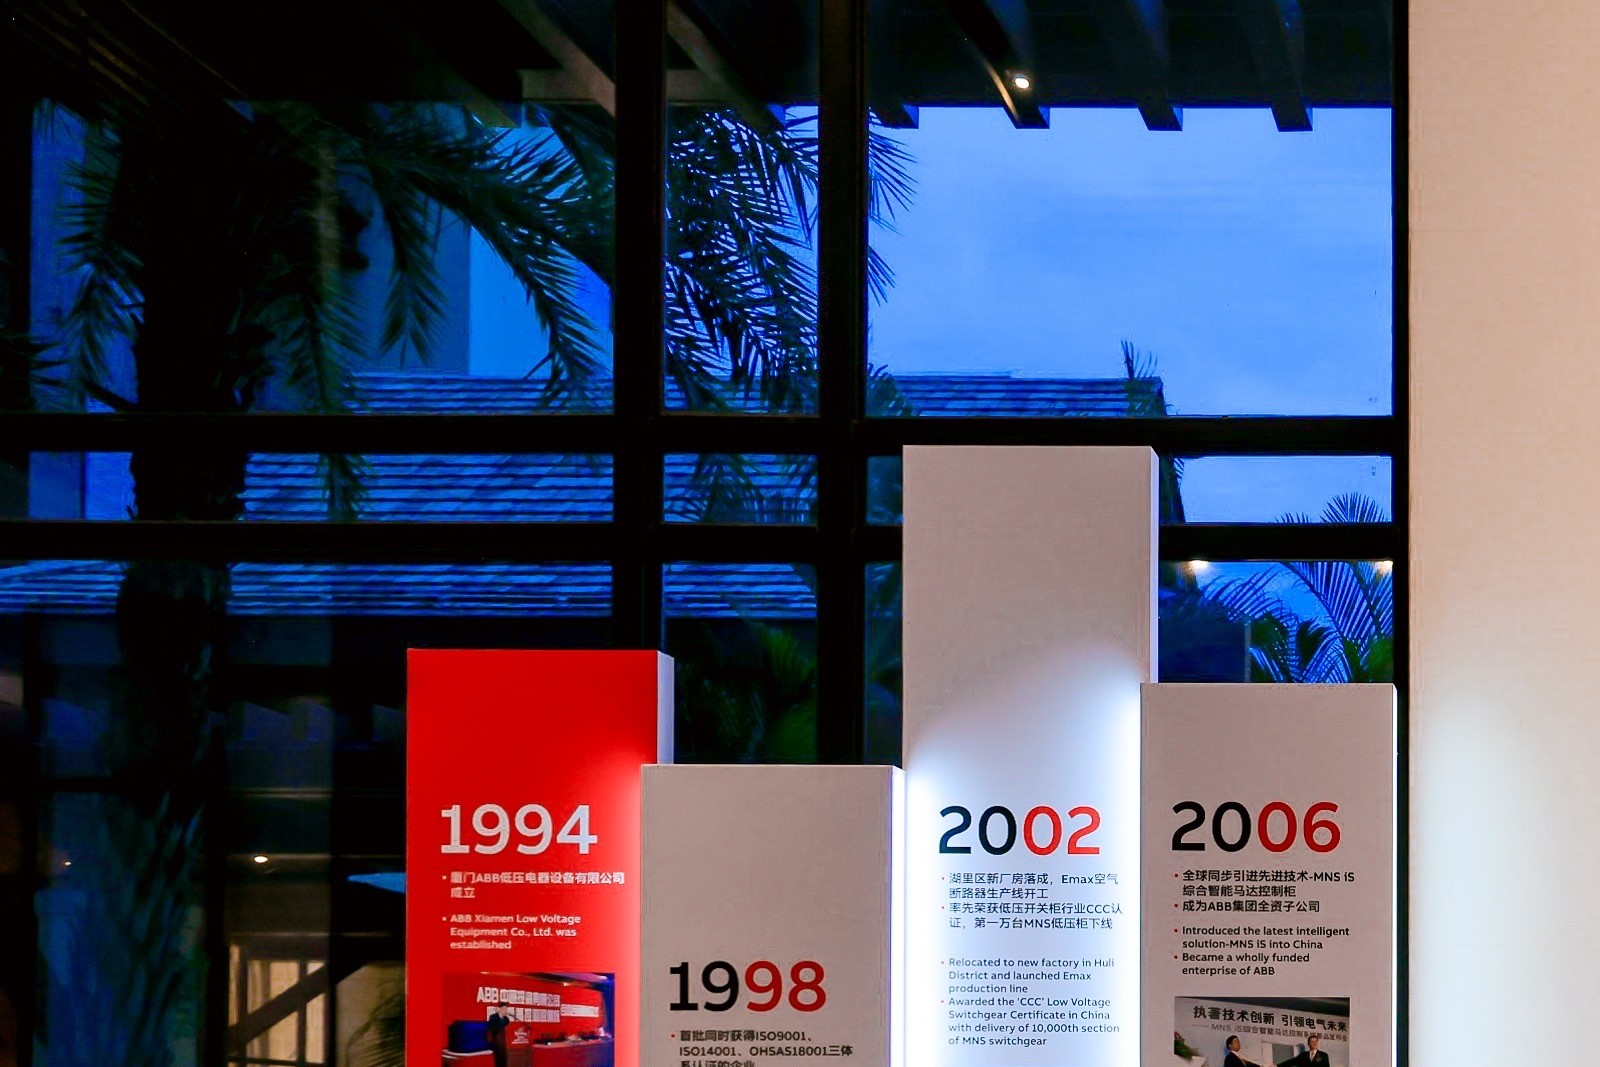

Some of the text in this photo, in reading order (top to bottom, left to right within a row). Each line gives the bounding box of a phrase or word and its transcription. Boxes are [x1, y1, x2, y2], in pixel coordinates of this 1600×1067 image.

[441, 804, 597, 855] 1994
[939, 806, 1100, 855] 2002
[1171, 801, 1341, 852] 2006
[1344, 872, 1354, 882] iS
[1183, 926, 1349, 938] Introduced the latest intelligent
[1183, 939, 1323, 949] solution-MNS iS into China
[950, 958, 1000, 966] Relocated
[1042, 958, 1079, 969] factory
[1183, 953, 1223, 961] Became
[1236, 953, 1269, 964] wholly
[1272, 953, 1309, 962] funded
[1014, 971, 1059, 980] launched
[1182, 966, 1275, 976] enterprise of ABB
[670, 961, 826, 1012] 1998
[949, 984, 1027, 994] production line
[998, 998, 1014, 1006] the
[1048, 998, 1068, 1006] Low
[1071, 998, 1110, 1008] Voltage
[949, 1011, 1109, 1021] Switchgear Certificate in China
[975, 1024, 1015, 1034] delivery
[1019, 1024, 1029, 1032] of
[989, 1037, 1046, 1047] switchgear
